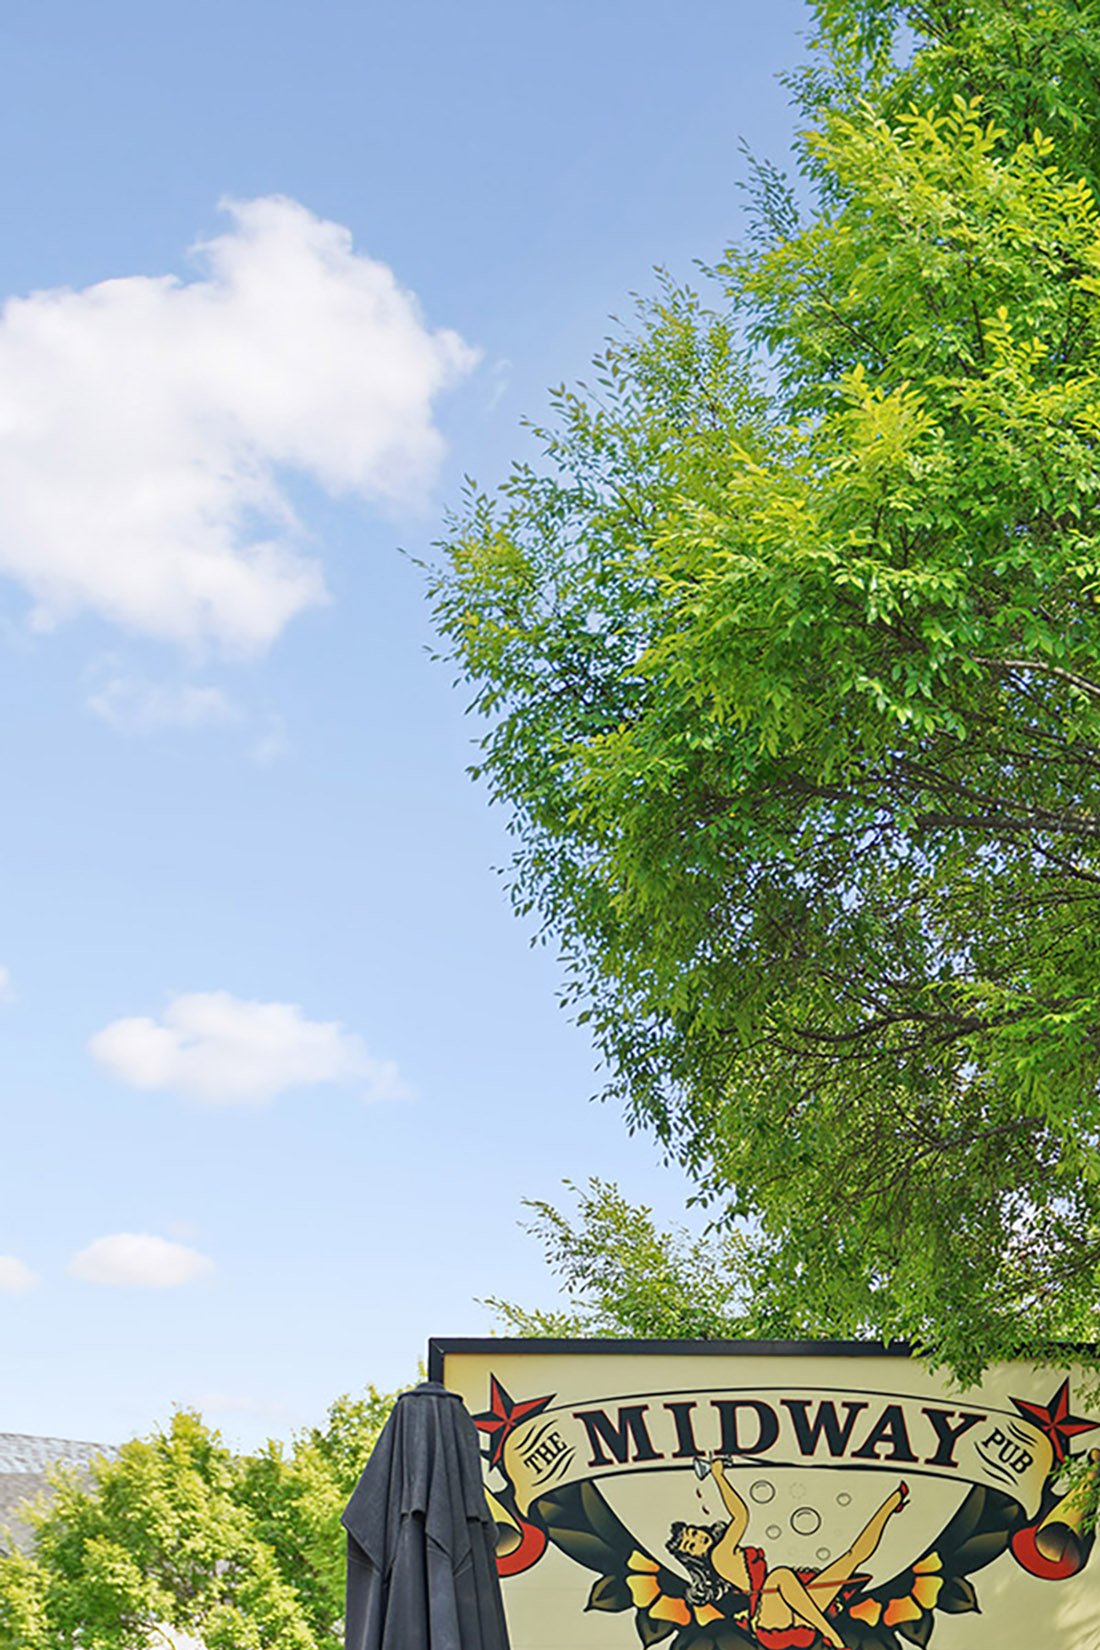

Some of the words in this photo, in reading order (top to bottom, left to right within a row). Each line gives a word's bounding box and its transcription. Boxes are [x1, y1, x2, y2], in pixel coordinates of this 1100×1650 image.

[523, 1431, 567, 1474] THE
[572, 1398, 988, 1469] MIDWAY
[981, 1427, 1034, 1475] PUB
